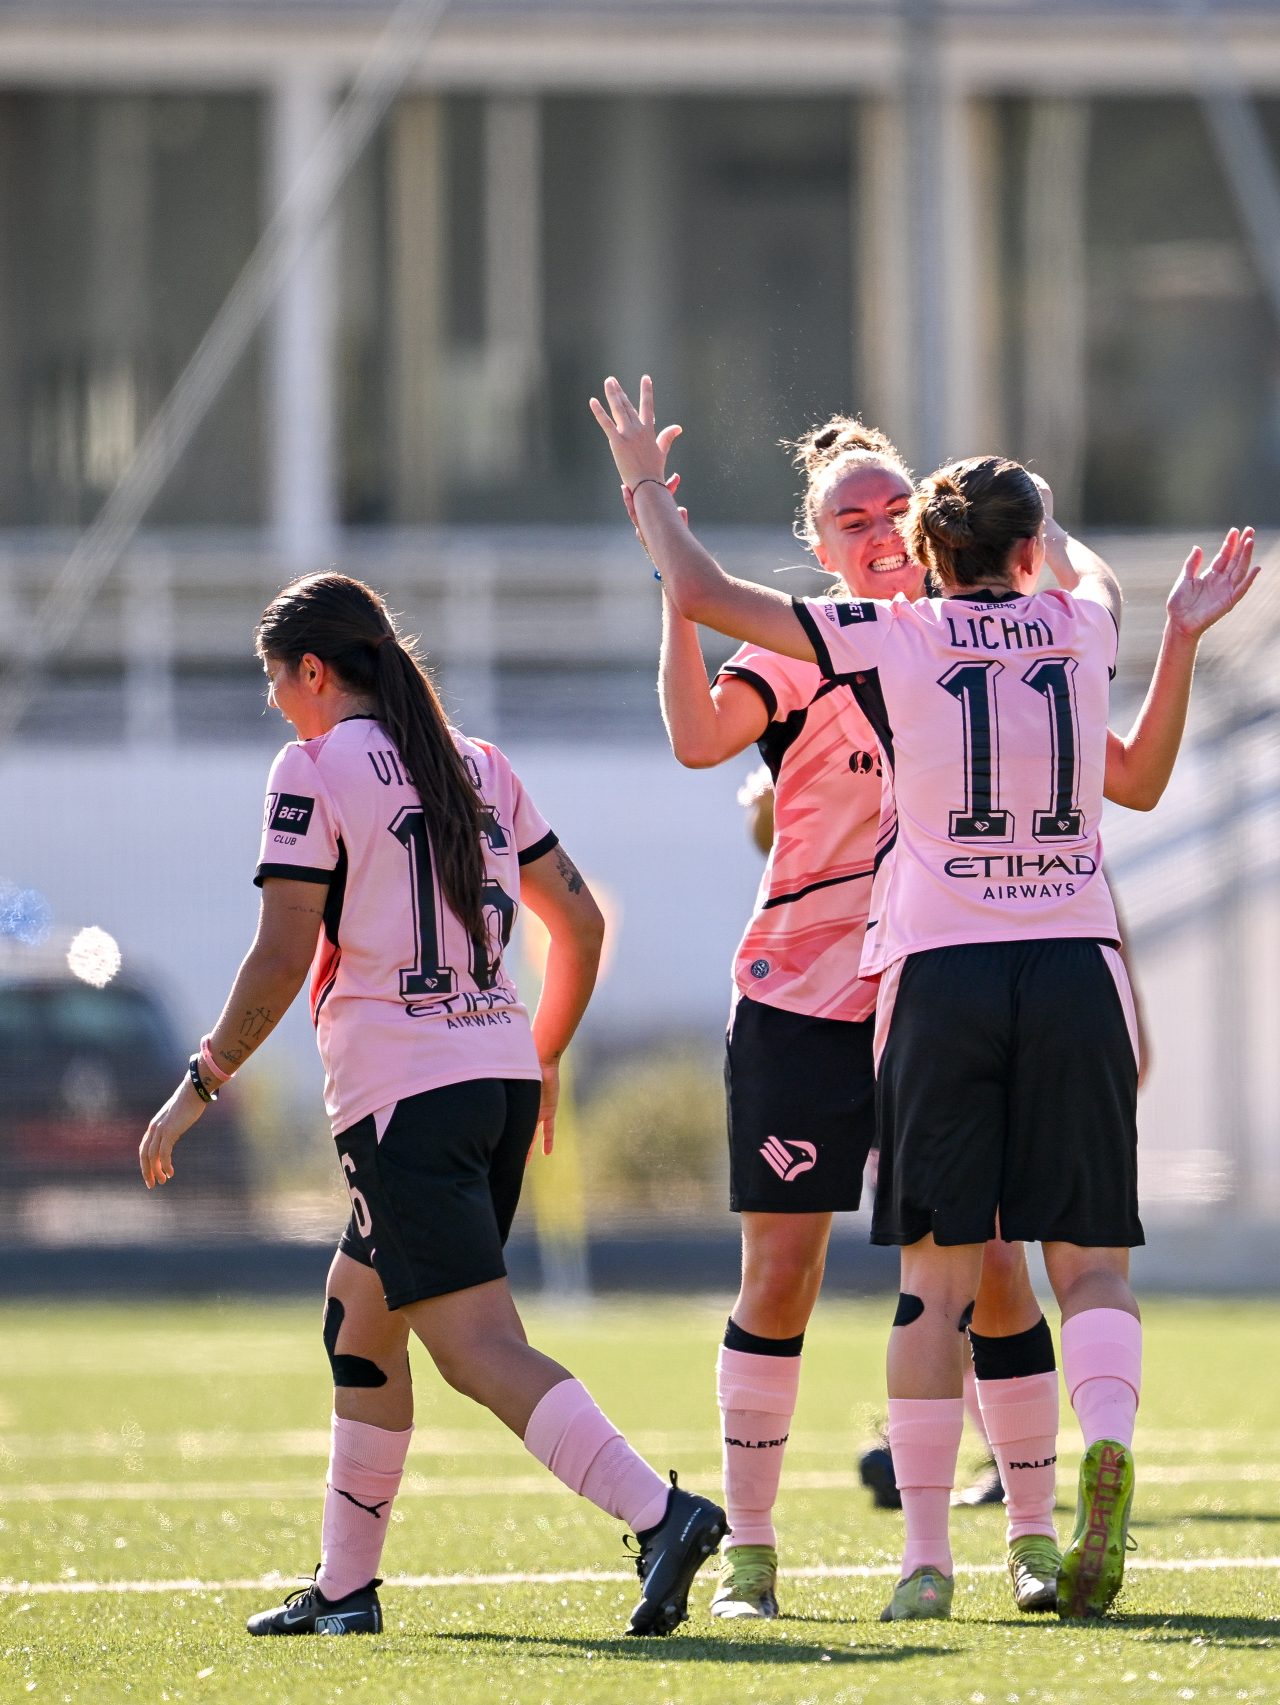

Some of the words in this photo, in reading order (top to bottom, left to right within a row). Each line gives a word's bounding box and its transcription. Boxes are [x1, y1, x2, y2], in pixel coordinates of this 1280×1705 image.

[936, 656, 1089, 844] 11
[278, 806, 309, 822] BET
[273, 834, 298, 846] CLUB
[943, 854, 1097, 879] ETIHAD
[982, 882, 1076, 900] AIRWAYS
[446, 1011, 512, 1030] AIRWAYS
